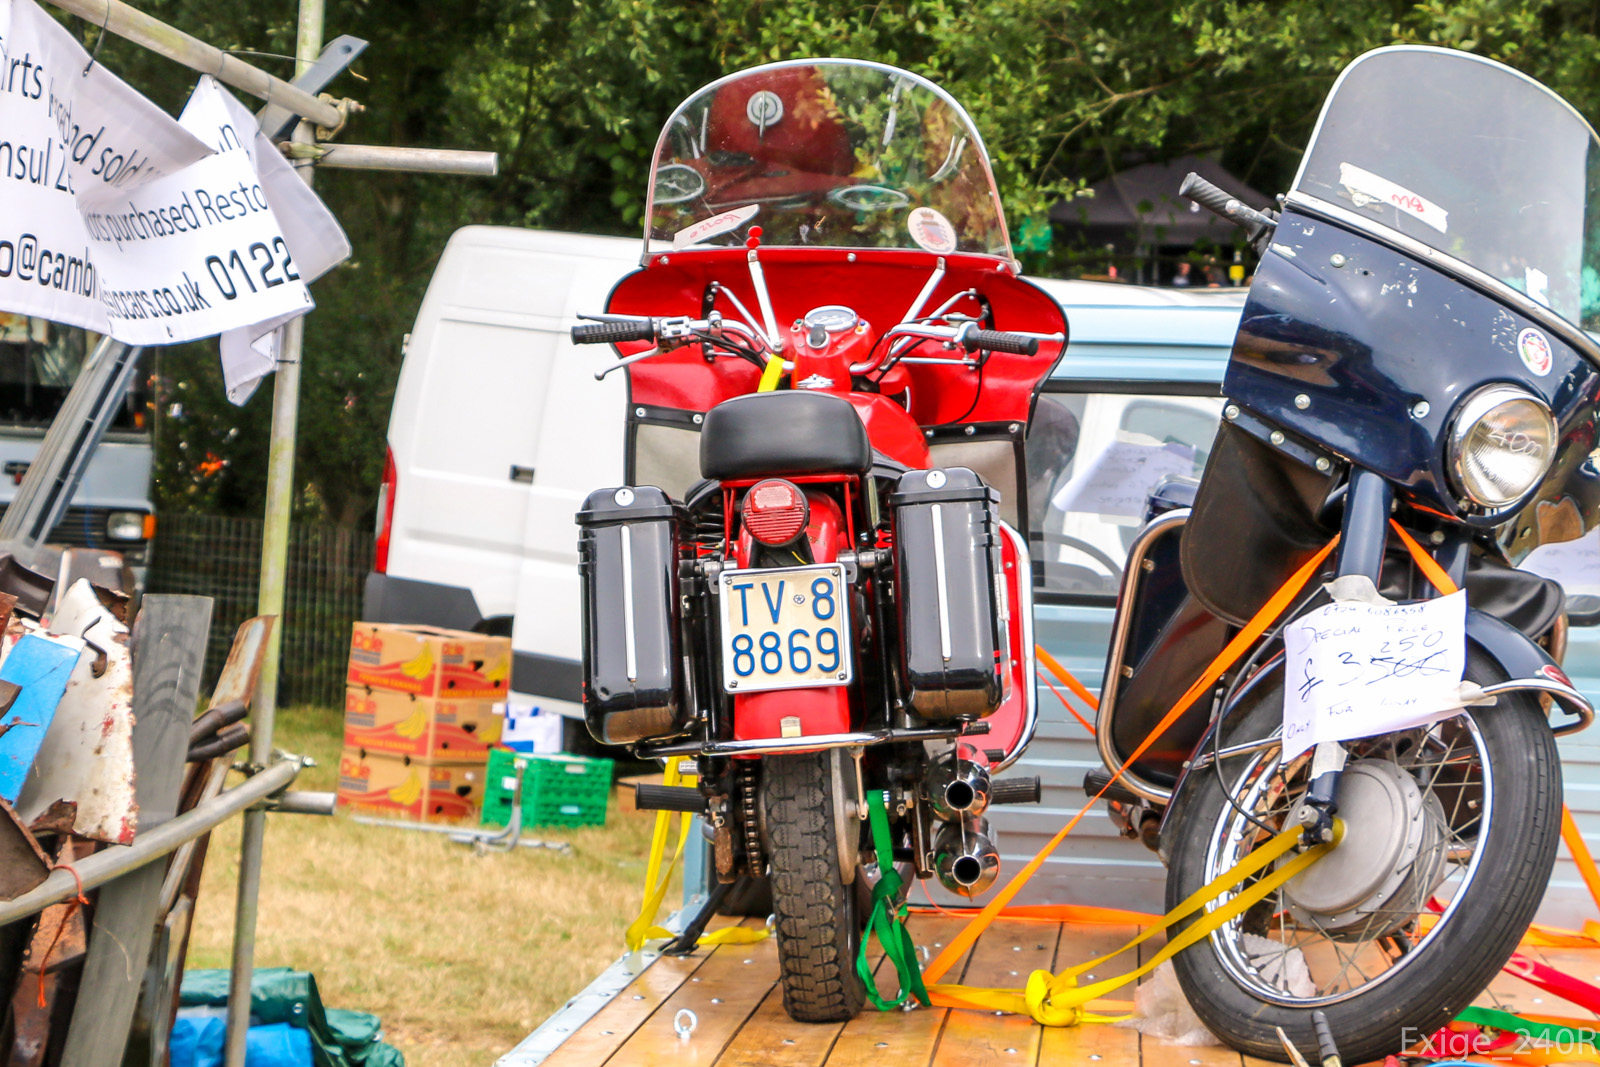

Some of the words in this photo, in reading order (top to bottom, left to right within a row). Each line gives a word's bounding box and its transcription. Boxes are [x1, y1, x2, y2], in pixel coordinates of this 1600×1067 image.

[106, 191, 201, 252] purchased
[204, 236, 300, 300] 0122
[732, 580, 785, 626] TV
[811, 577, 835, 620] 8
[352, 630, 383, 653] Dole
[731, 627, 840, 677] 8869
